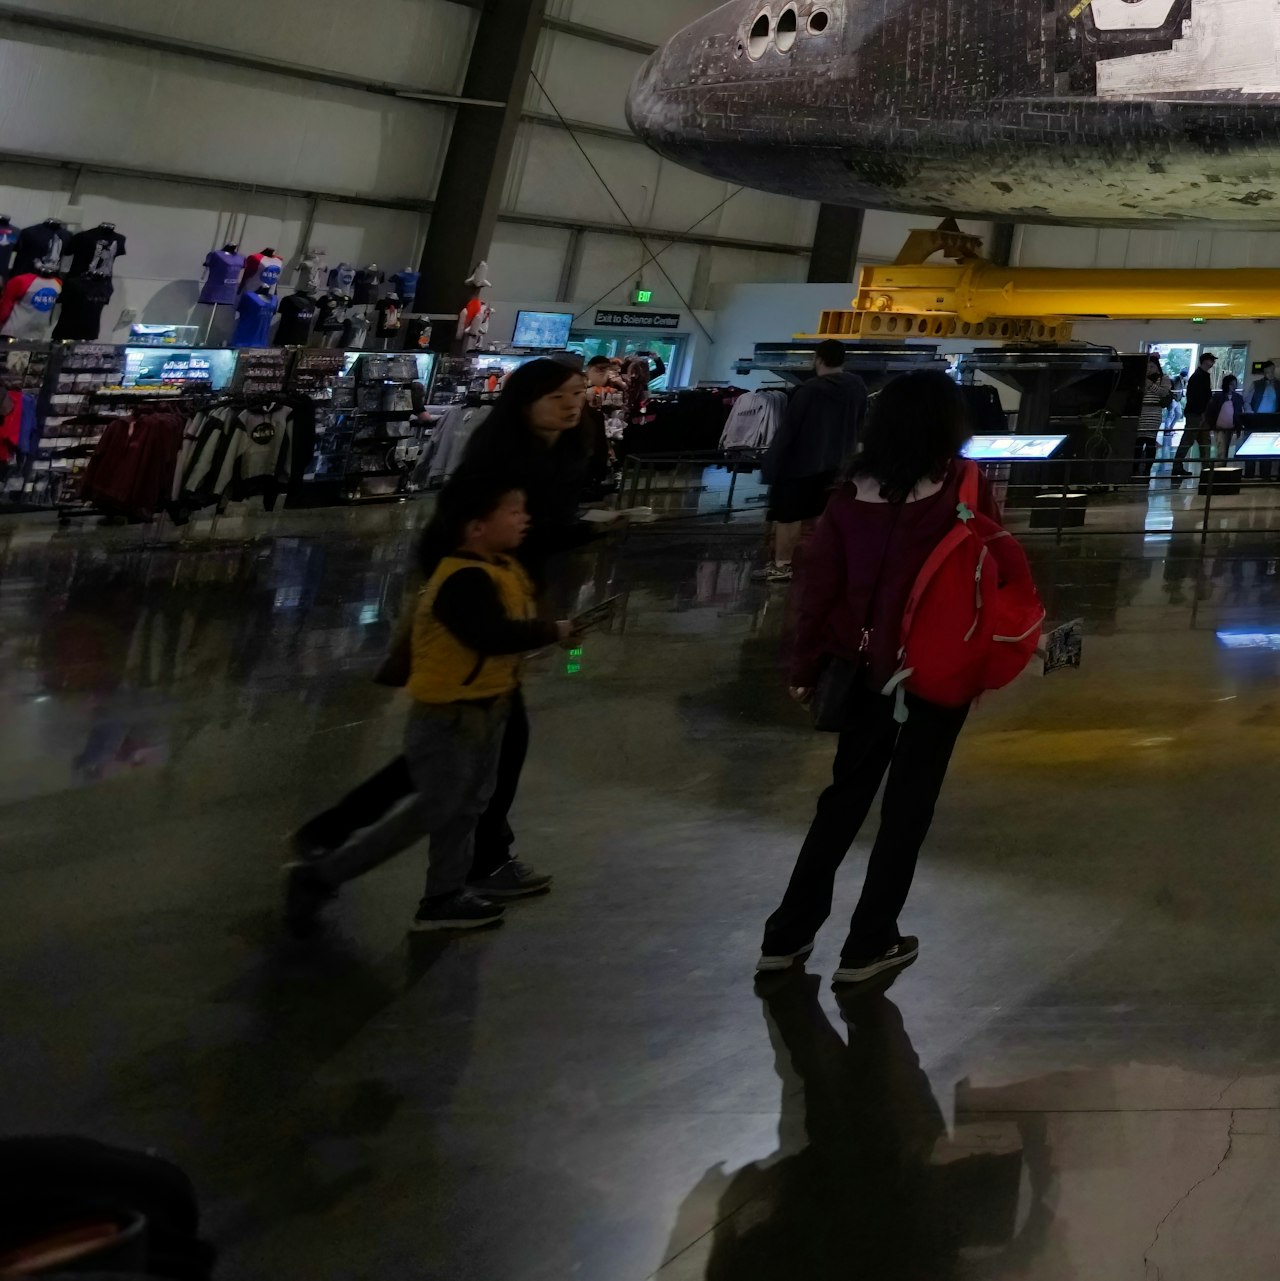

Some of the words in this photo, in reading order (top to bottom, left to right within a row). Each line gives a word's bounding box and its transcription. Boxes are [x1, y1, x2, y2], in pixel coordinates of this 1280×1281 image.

[638, 291, 651, 302] EXIT
[597, 314, 612, 323] Exit
[613, 315, 621, 323] to
[622, 314, 652, 325] Science
[653, 316, 678, 325] Center
